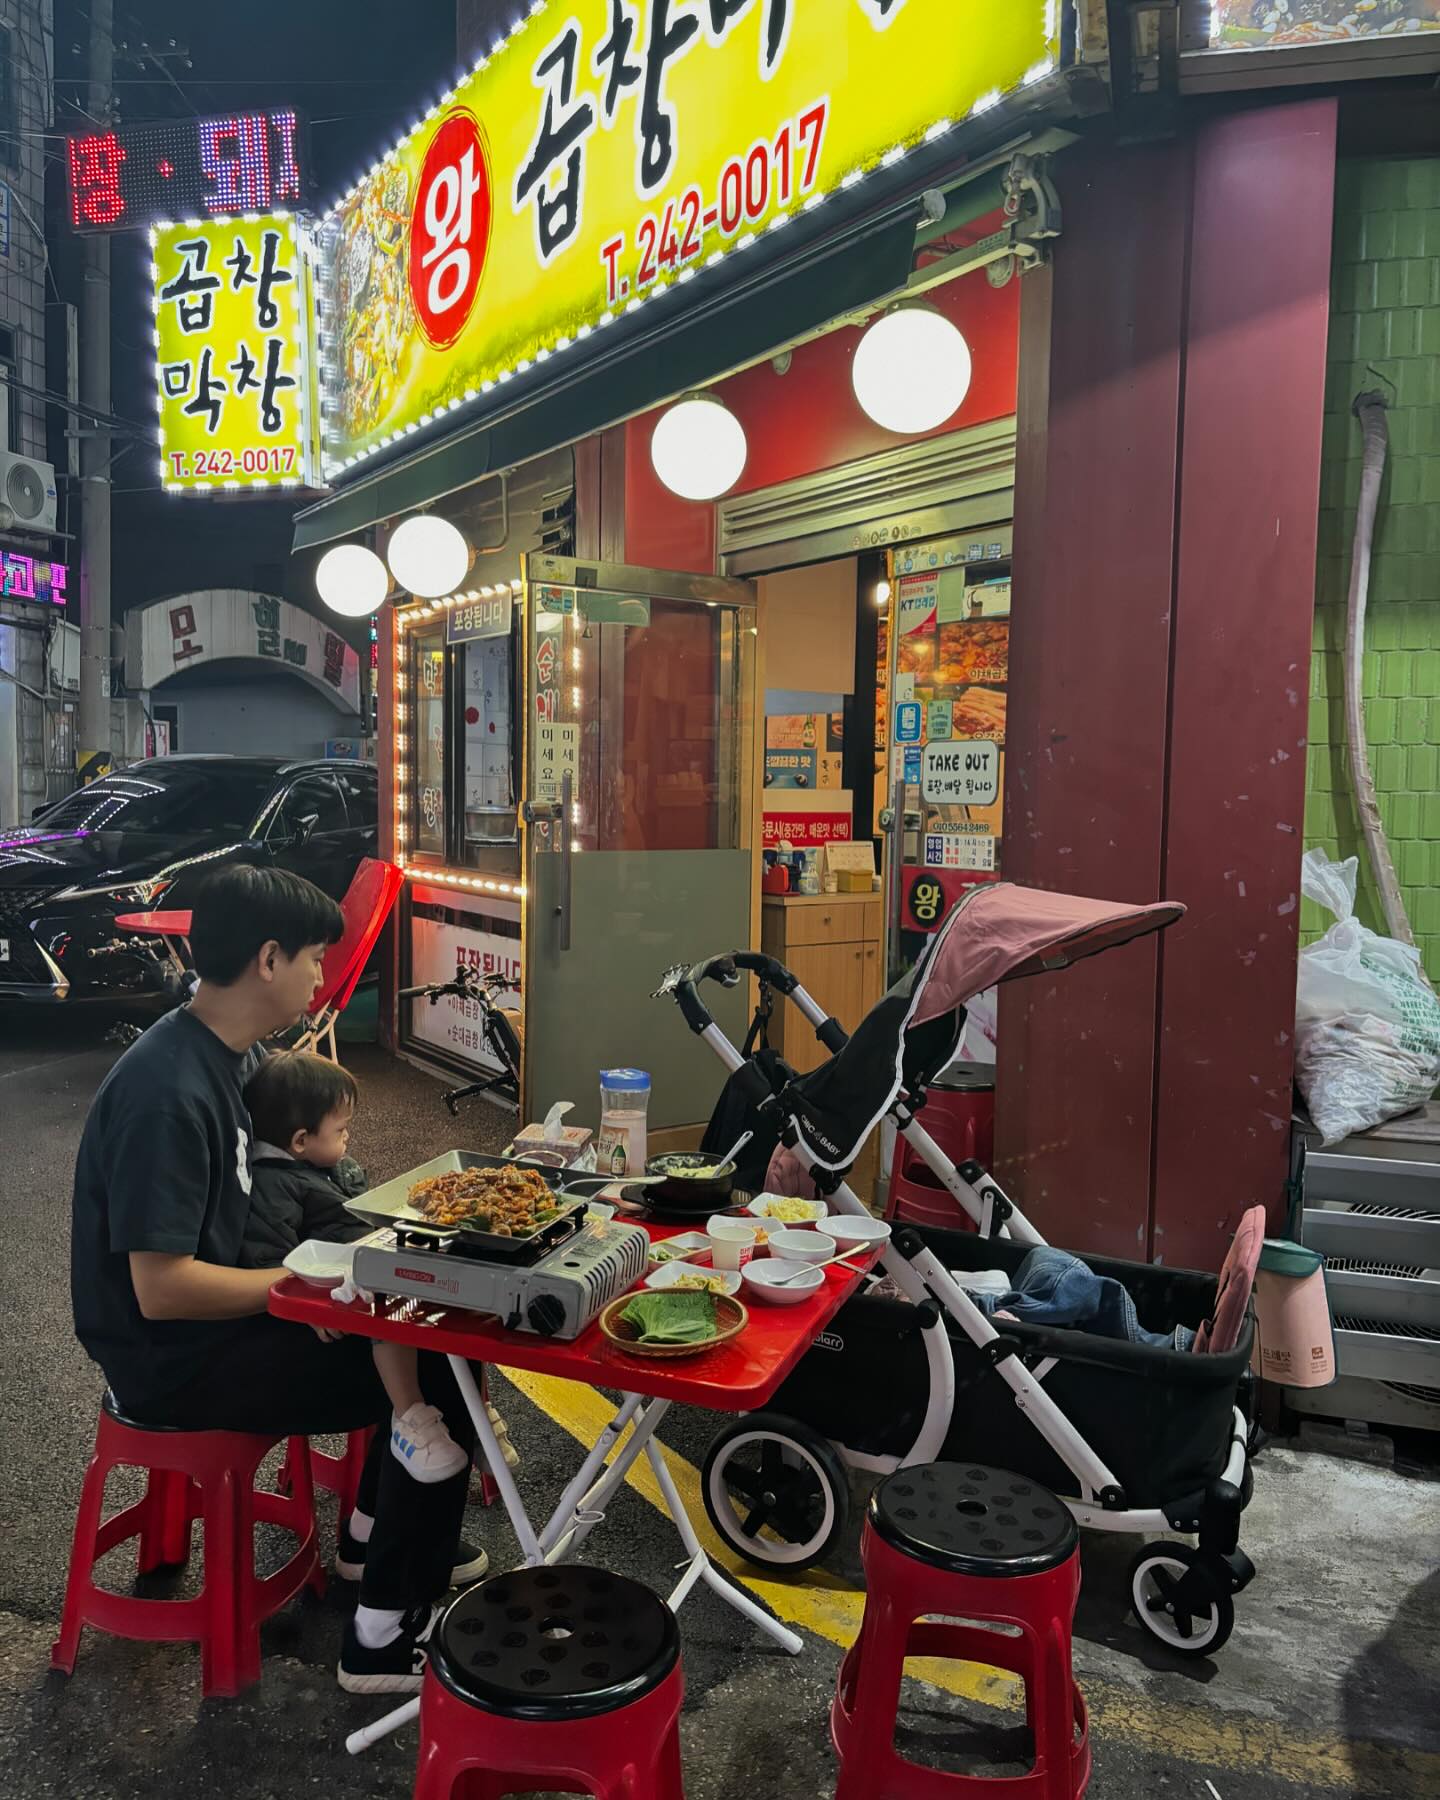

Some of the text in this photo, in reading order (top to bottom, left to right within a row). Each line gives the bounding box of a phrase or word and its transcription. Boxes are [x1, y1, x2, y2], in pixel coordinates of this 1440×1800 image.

[601, 103, 827, 303] T. 242-0017
[422, 142, 481, 315] 왕
[161, 233, 294, 331] 곱창
[162, 339, 296, 434] 막창
[171, 447, 296, 477] T. 242-0017
[454, 600, 504, 632] 포장됩니다
[541, 728, 554, 780] 미세요
[928, 754, 960, 772] TAKE
[965, 754, 990, 772] OUT
[965, 779, 992, 795] 됩니다
[927, 838, 942, 850] 영업
[927, 850, 942, 863] 시간
[914, 884, 941, 920] 왕
[819, 1136, 841, 1156] BABY
